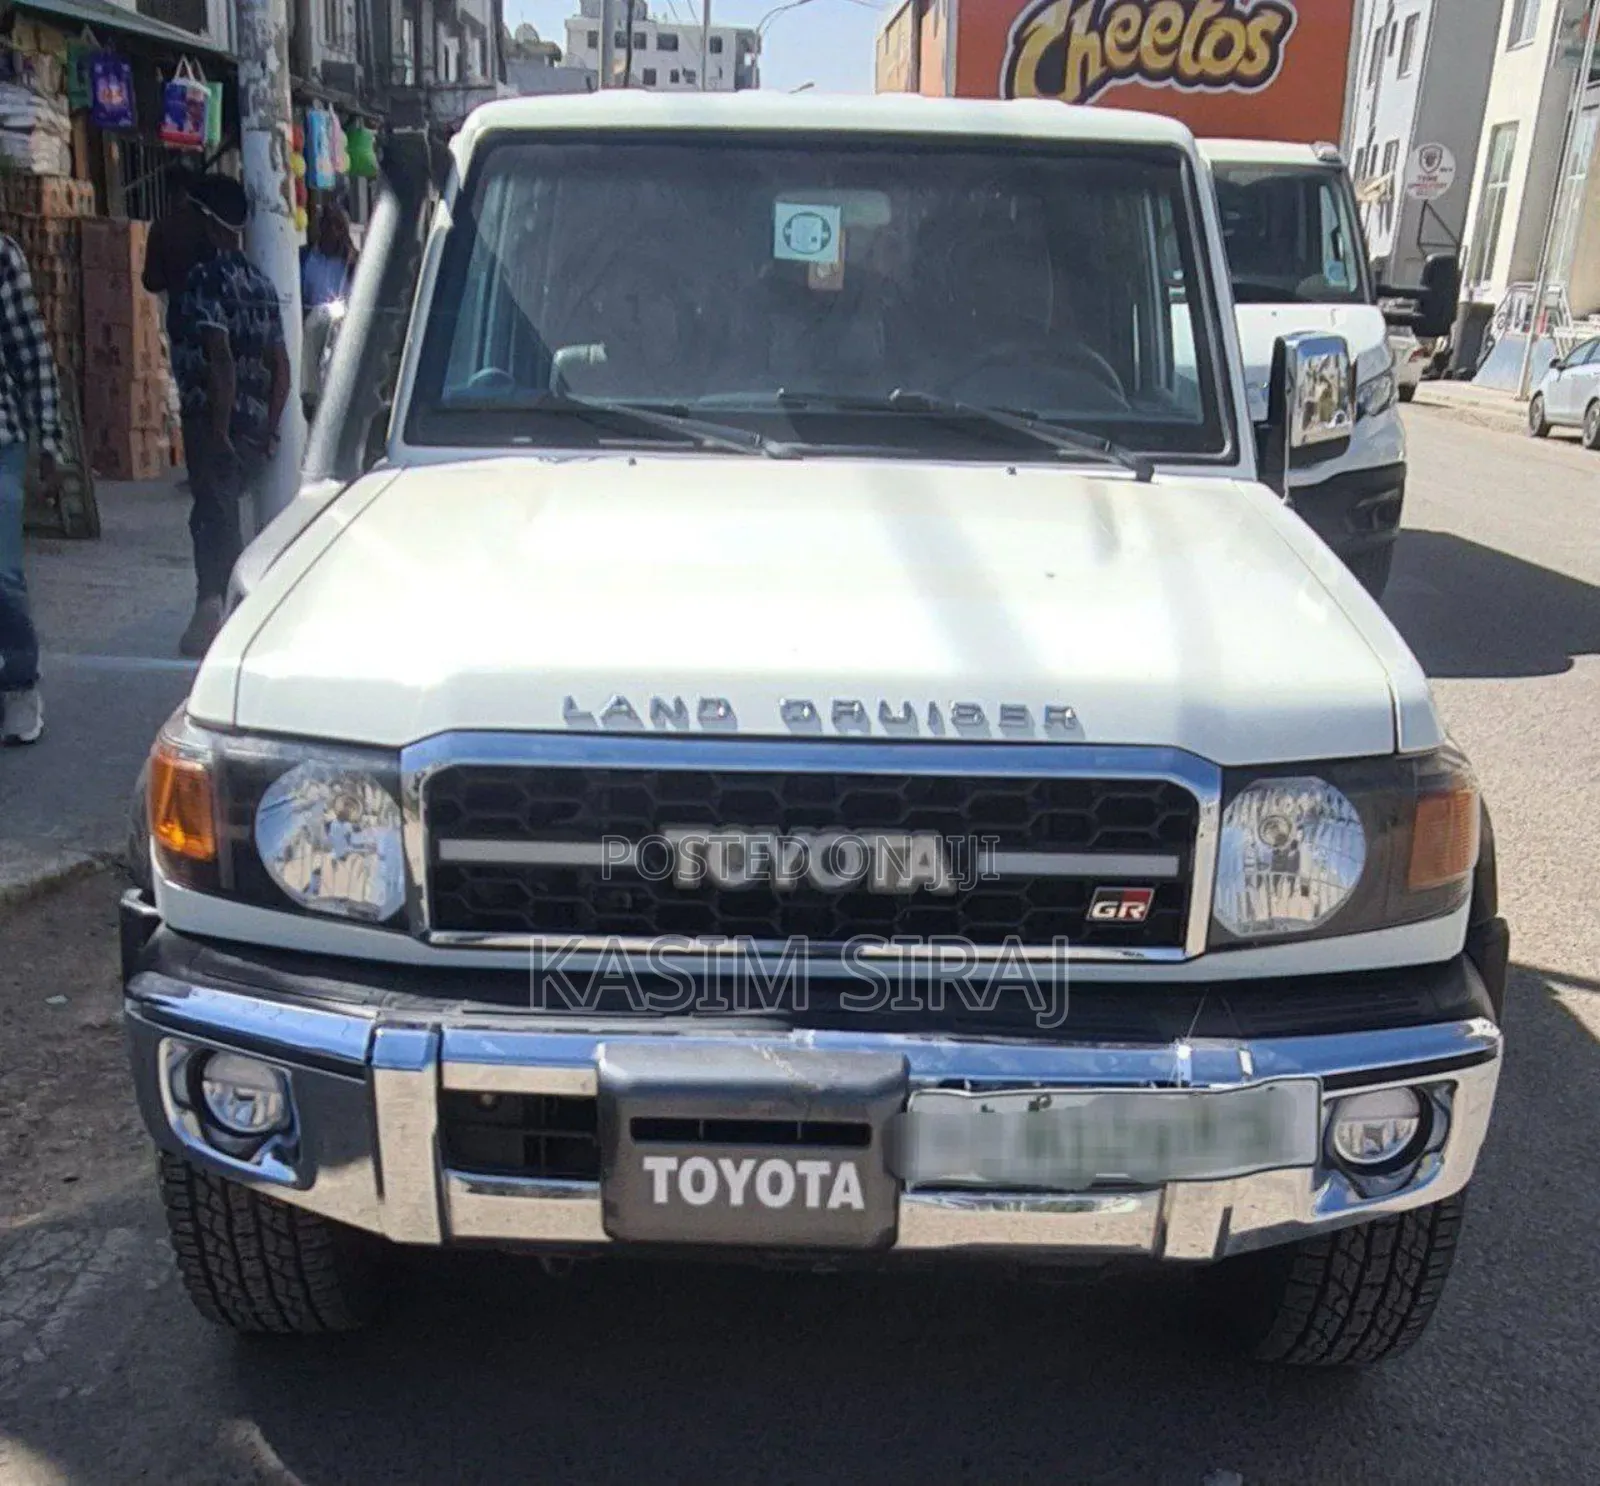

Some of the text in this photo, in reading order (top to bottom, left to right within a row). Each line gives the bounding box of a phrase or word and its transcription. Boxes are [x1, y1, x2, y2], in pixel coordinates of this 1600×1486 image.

[1012, 0, 1284, 103] Cheetos
[563, 695, 1081, 734] LAND CRUISER
[661, 823, 957, 896] TOYOTA
[1091, 900, 1147, 920] GR
[643, 1155, 866, 1211] TOYOTA
